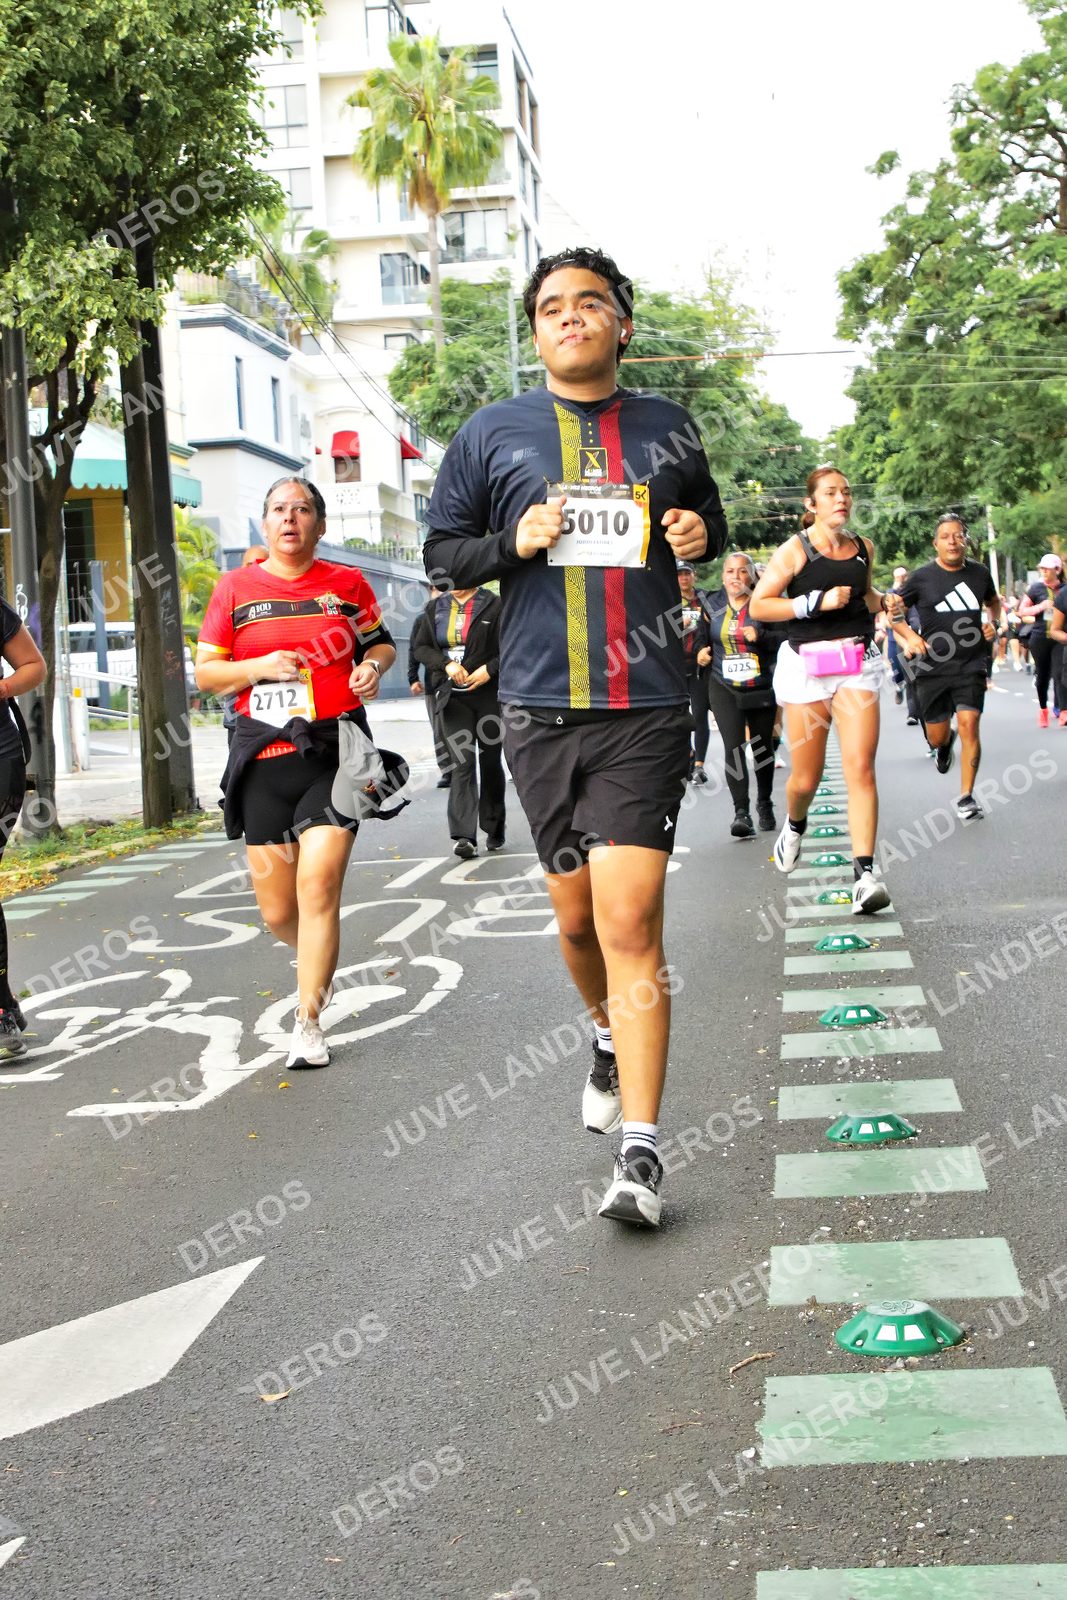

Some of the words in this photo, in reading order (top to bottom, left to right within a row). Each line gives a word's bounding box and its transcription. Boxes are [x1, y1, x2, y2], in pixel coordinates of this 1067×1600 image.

[562, 509, 630, 536] 5010
[728, 661, 752, 673] 6725
[253, 688, 298, 711] 2712
